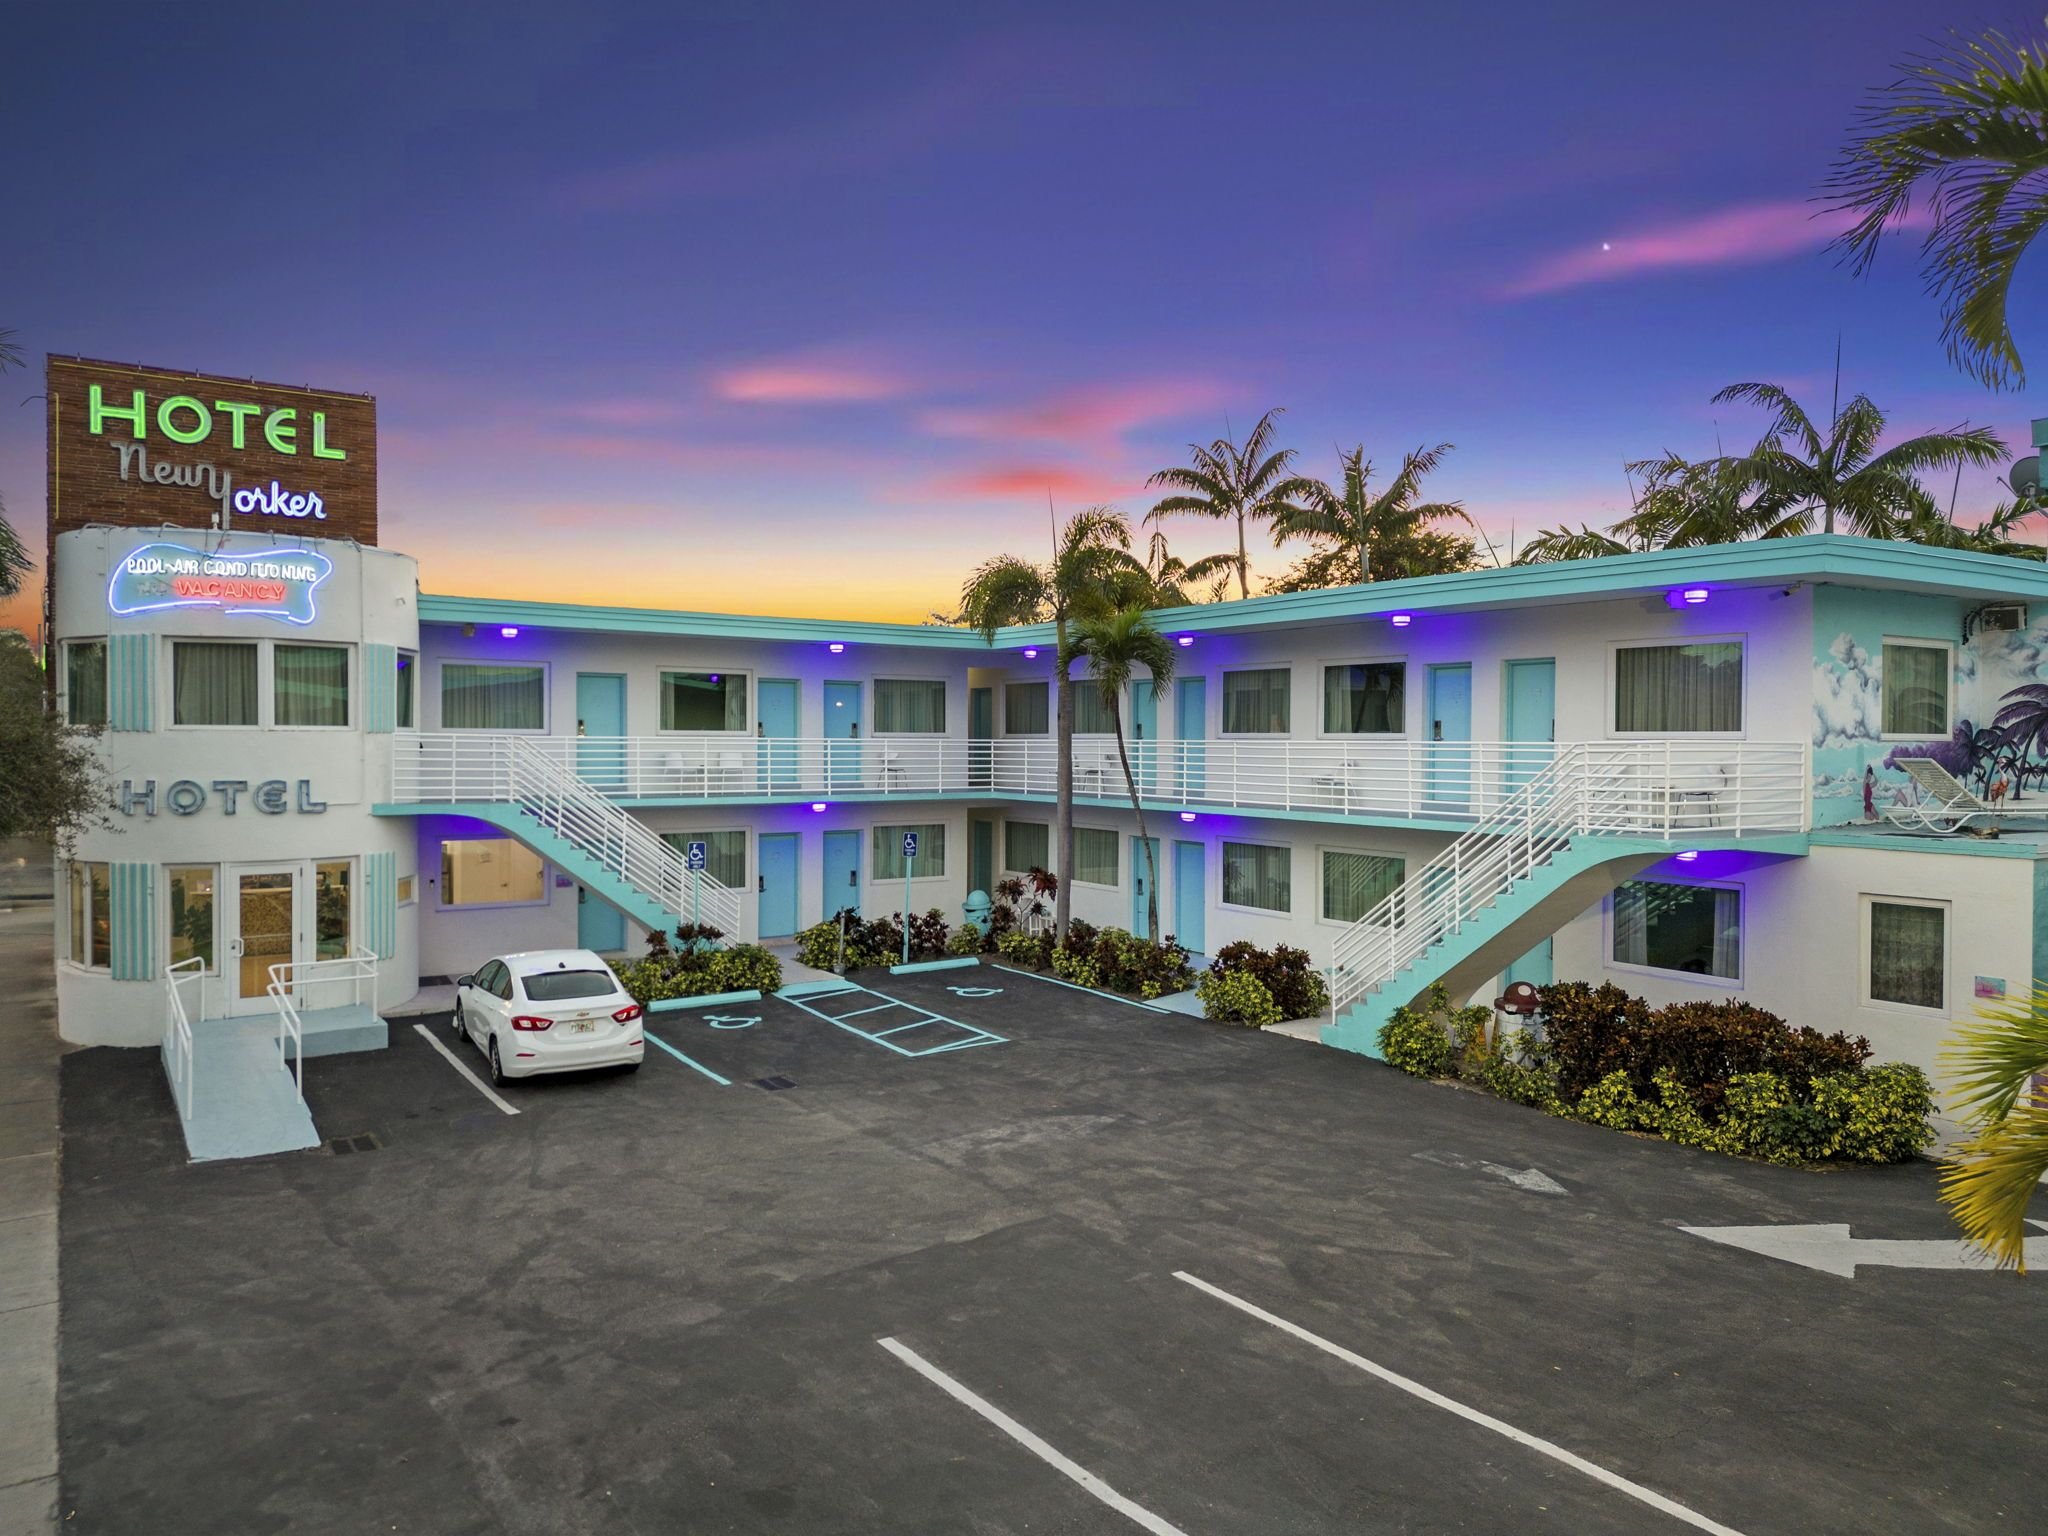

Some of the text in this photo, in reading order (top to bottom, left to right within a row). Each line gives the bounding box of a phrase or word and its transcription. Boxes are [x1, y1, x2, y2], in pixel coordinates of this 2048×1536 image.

[89, 384, 347, 460] HOTEL
[110, 441, 327, 530] New Yorker
[203, 560, 317, 582] CONDITIONING
[176, 581, 285, 600] VACANCY
[122, 779, 327, 816] HOTEL
